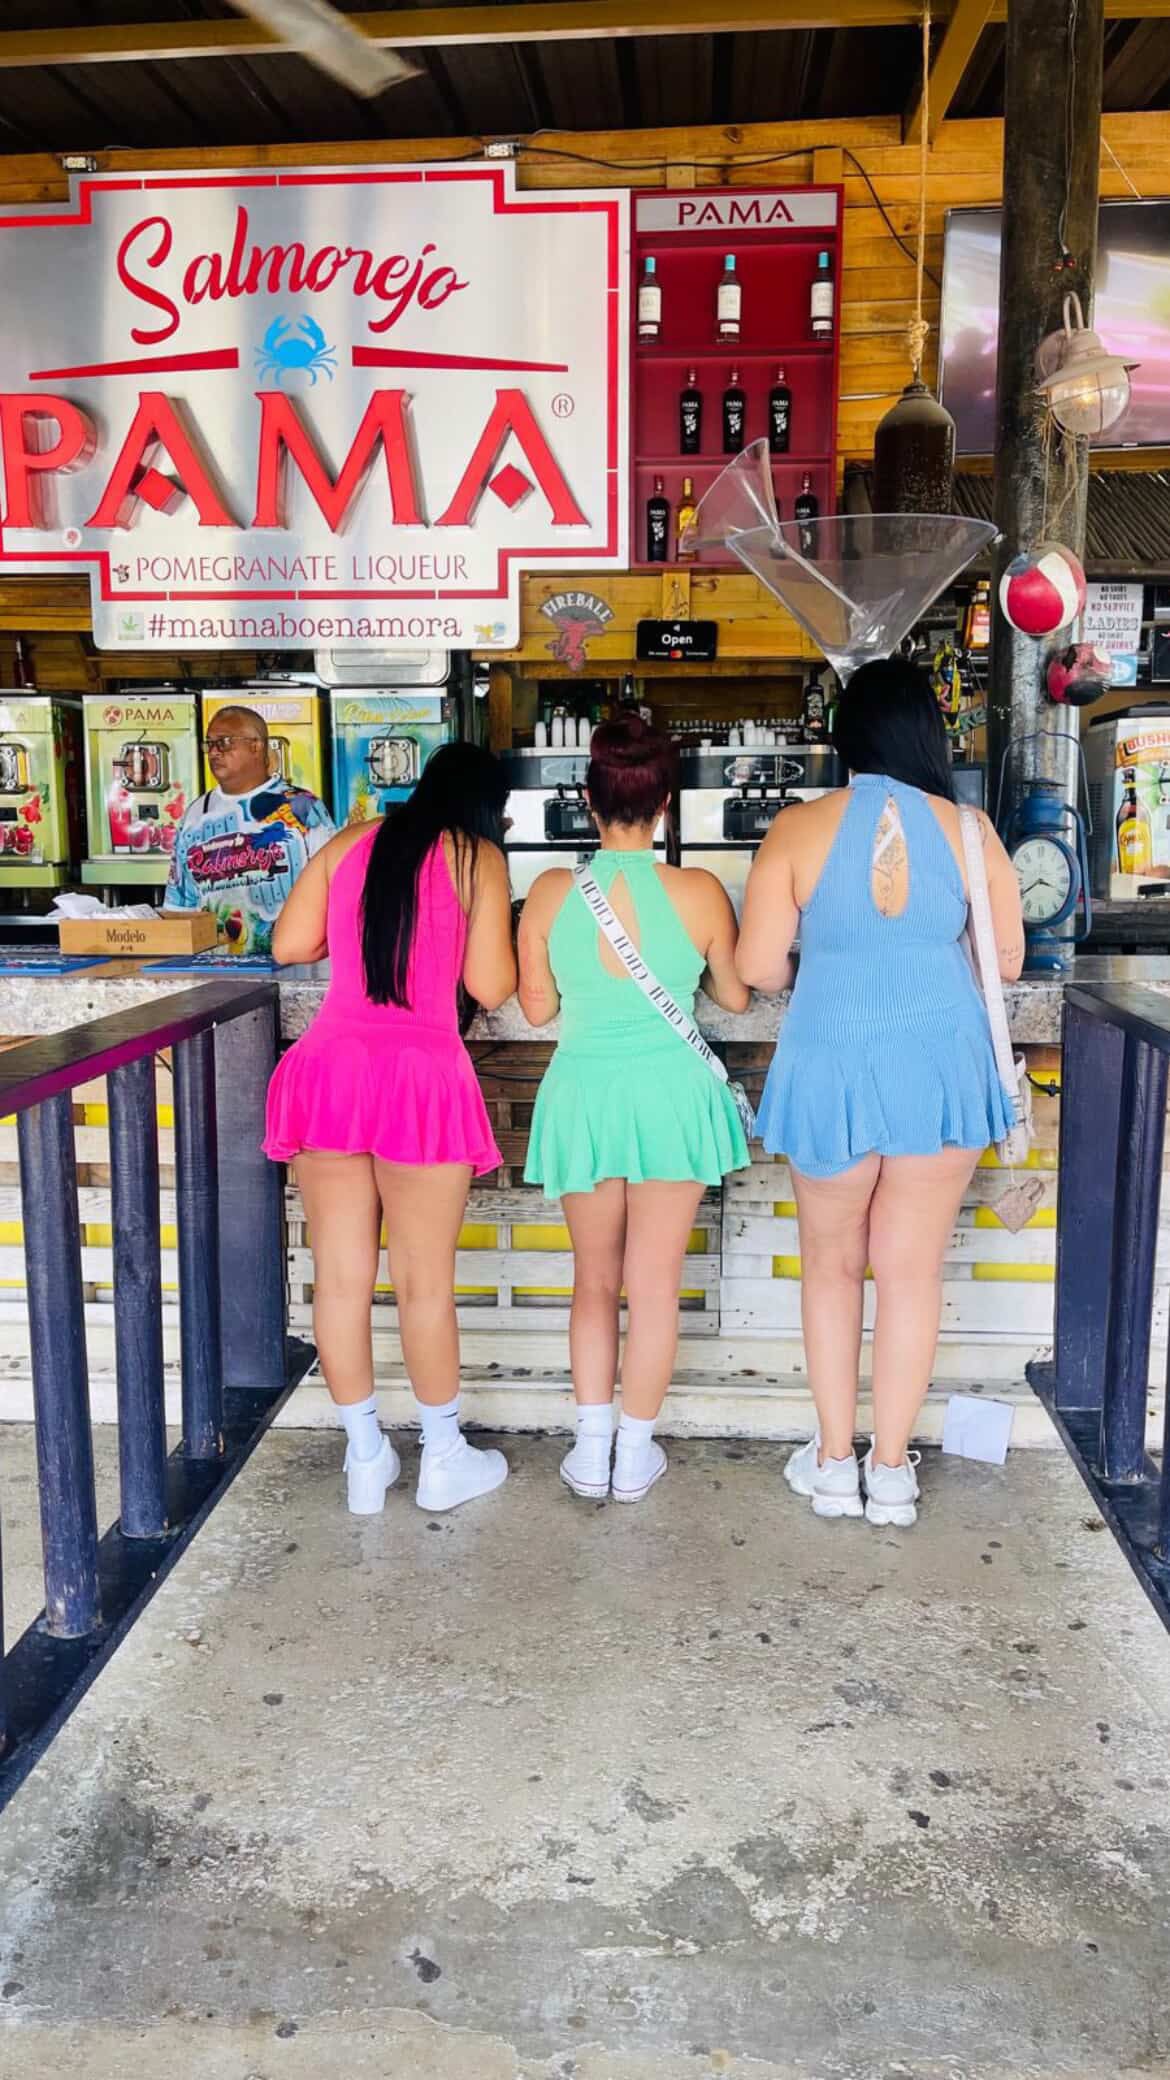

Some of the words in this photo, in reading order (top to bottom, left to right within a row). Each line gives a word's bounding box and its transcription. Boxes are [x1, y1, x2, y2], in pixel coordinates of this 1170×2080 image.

[678, 199, 795, 225] PAMA
[117, 205, 470, 345] Salmorejo
[0, 388, 593, 534] PAMA
[136, 556, 339, 582] POMEGRANATE
[352, 554, 469, 584] LIQUEUR
[541, 592, 613, 623] FIREBALL
[148, 612, 463, 639] #maunaboenamora
[661, 634, 693, 647] Open
[125, 708, 175, 721] PAMA
[106, 928, 146, 943] Modelo
